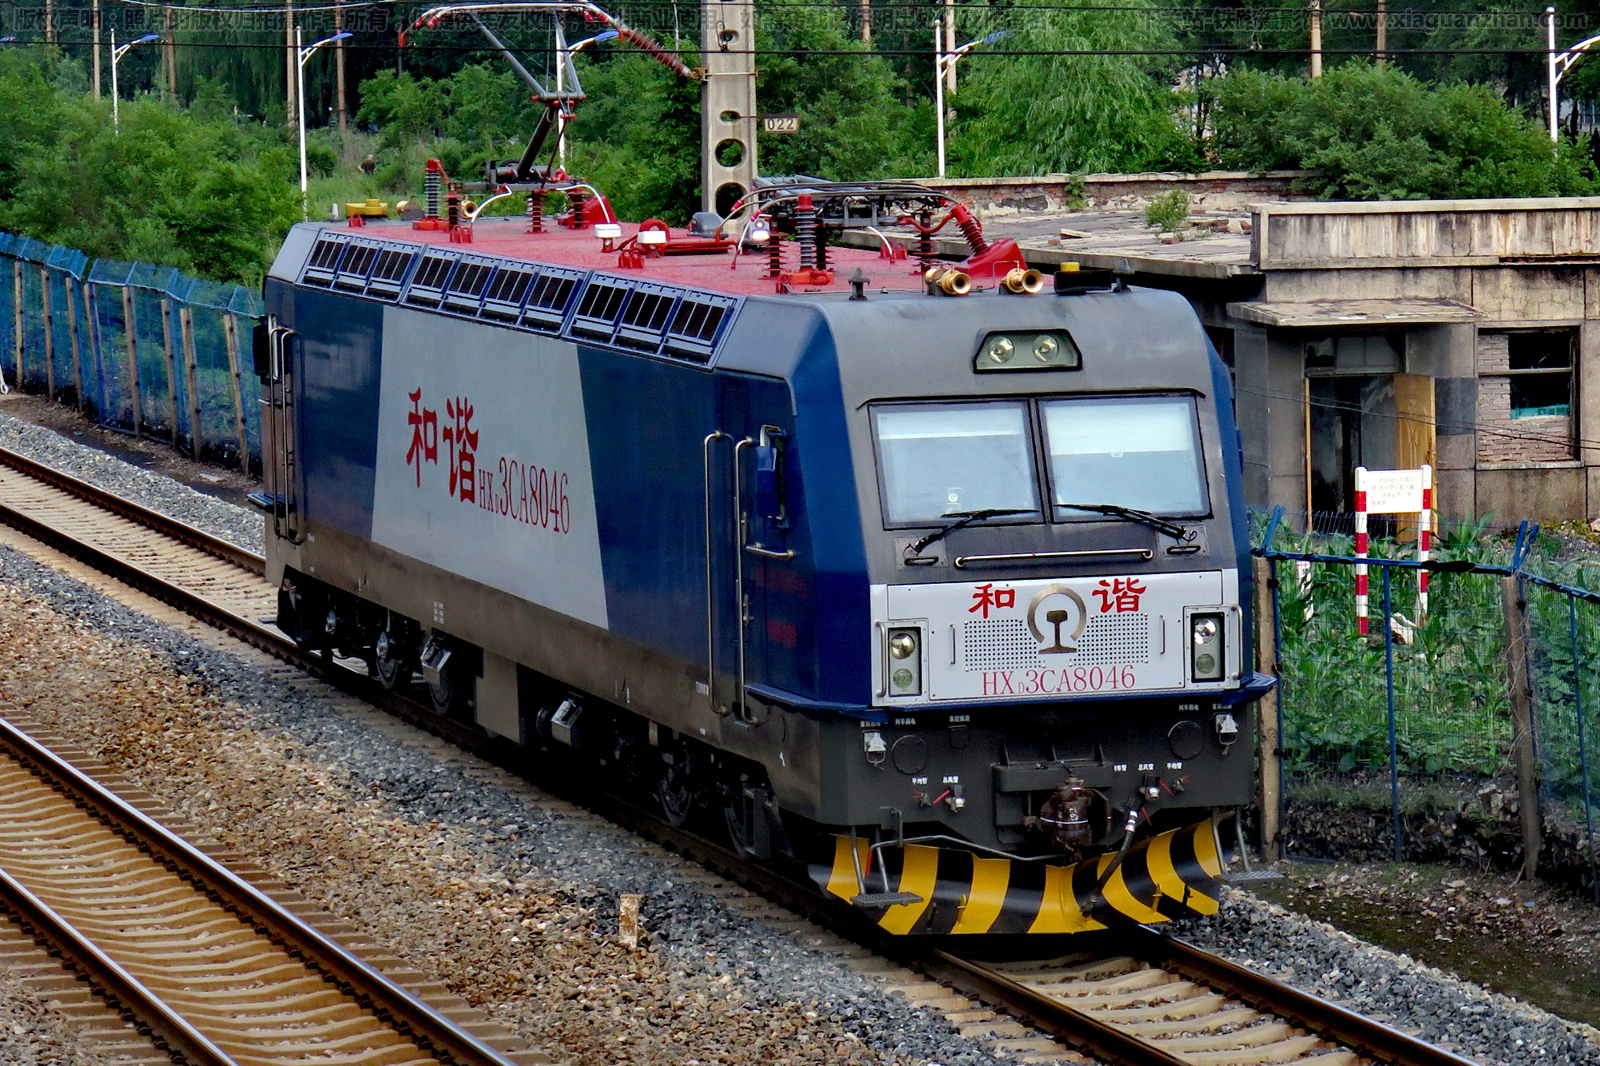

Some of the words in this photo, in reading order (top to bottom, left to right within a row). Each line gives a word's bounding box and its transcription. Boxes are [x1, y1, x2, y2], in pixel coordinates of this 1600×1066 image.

[767, 118, 794, 130] 022
[406, 386, 479, 504] 和谐
[968, 583, 1015, 619] 和
[1091, 577, 1146, 614] 谐
[981, 664, 1136, 696] HXD3CA8046
